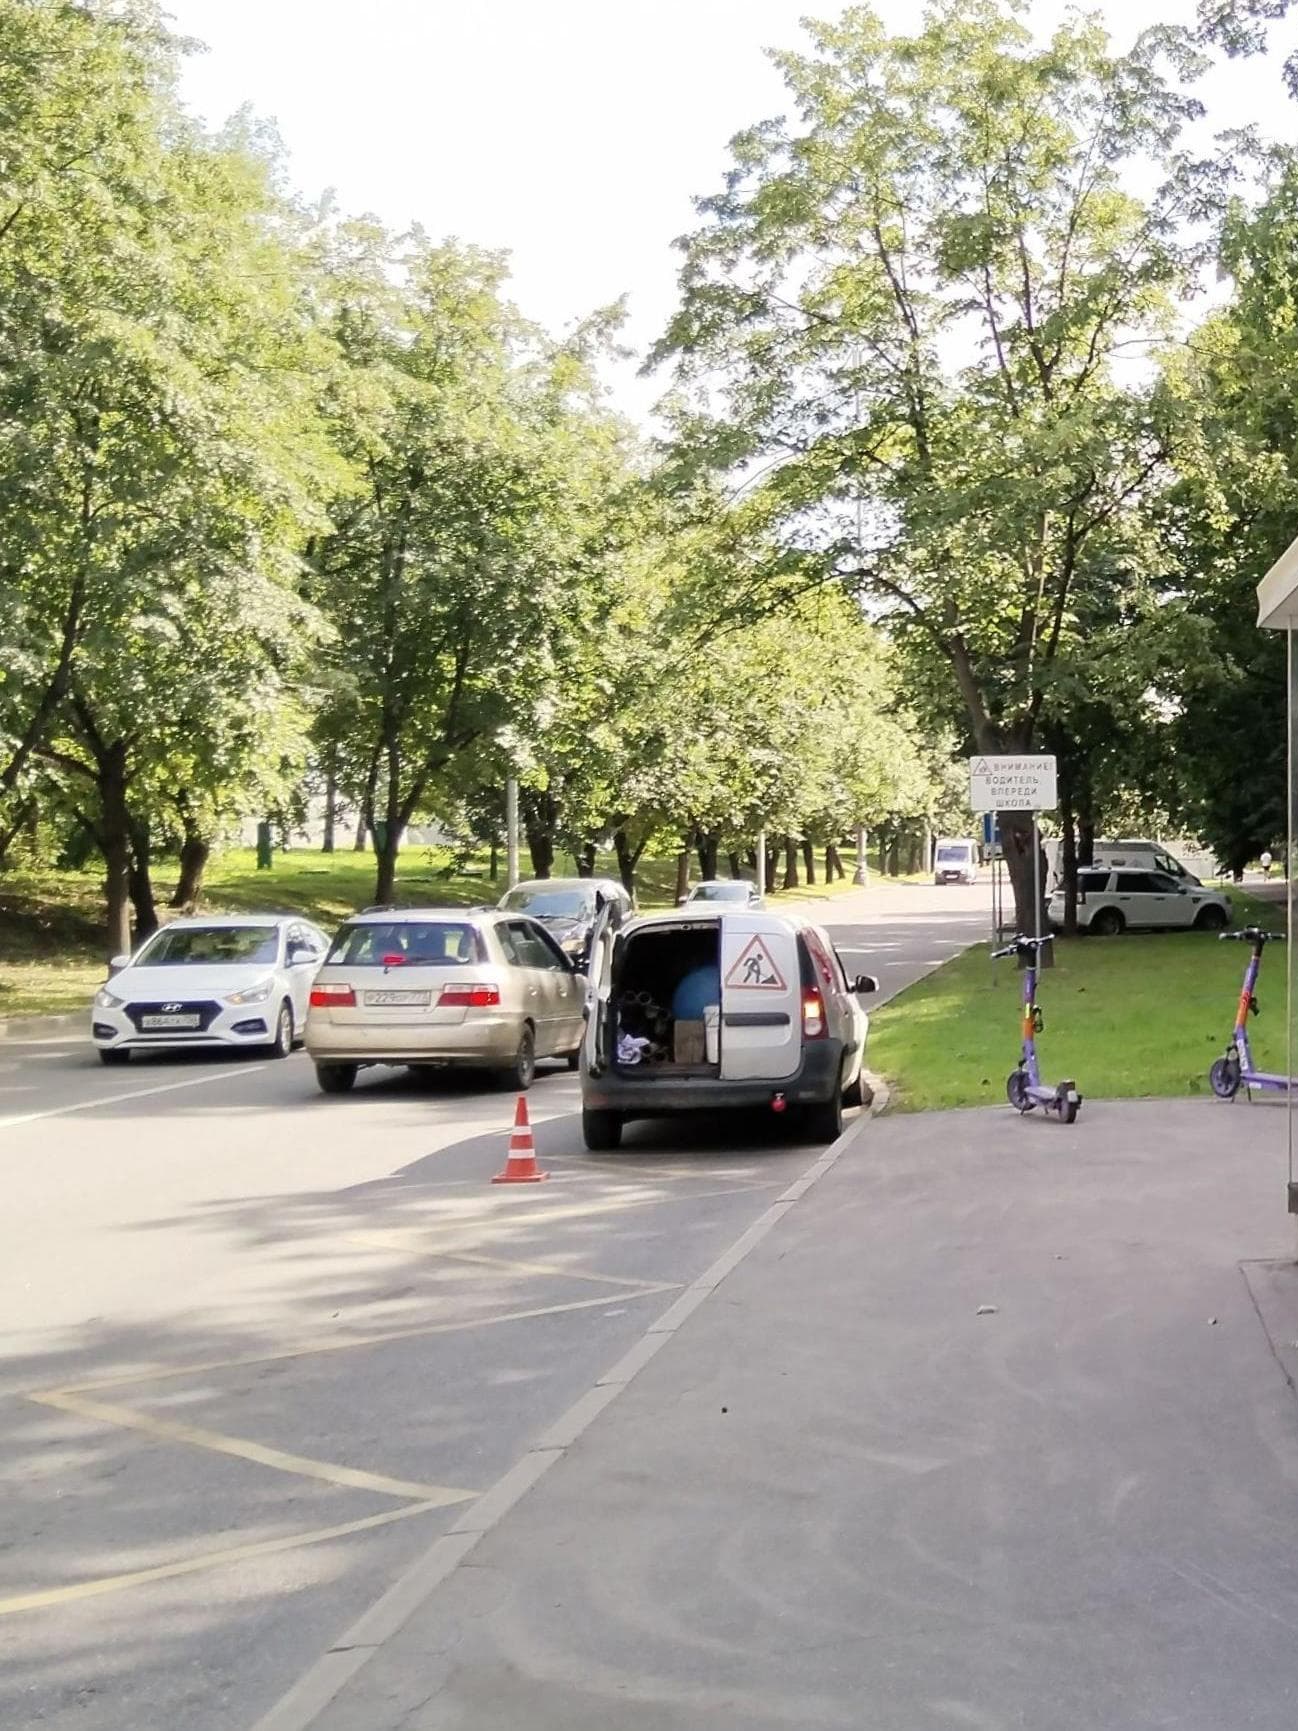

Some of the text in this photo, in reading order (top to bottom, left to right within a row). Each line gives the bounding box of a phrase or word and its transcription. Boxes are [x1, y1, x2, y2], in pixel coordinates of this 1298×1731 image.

[985, 776, 1039, 785] ВОДИТЕЛЬ
[991, 788, 1037, 796] ВПЕРЕДИ
[995, 799, 1032, 807] ШКОЛА
